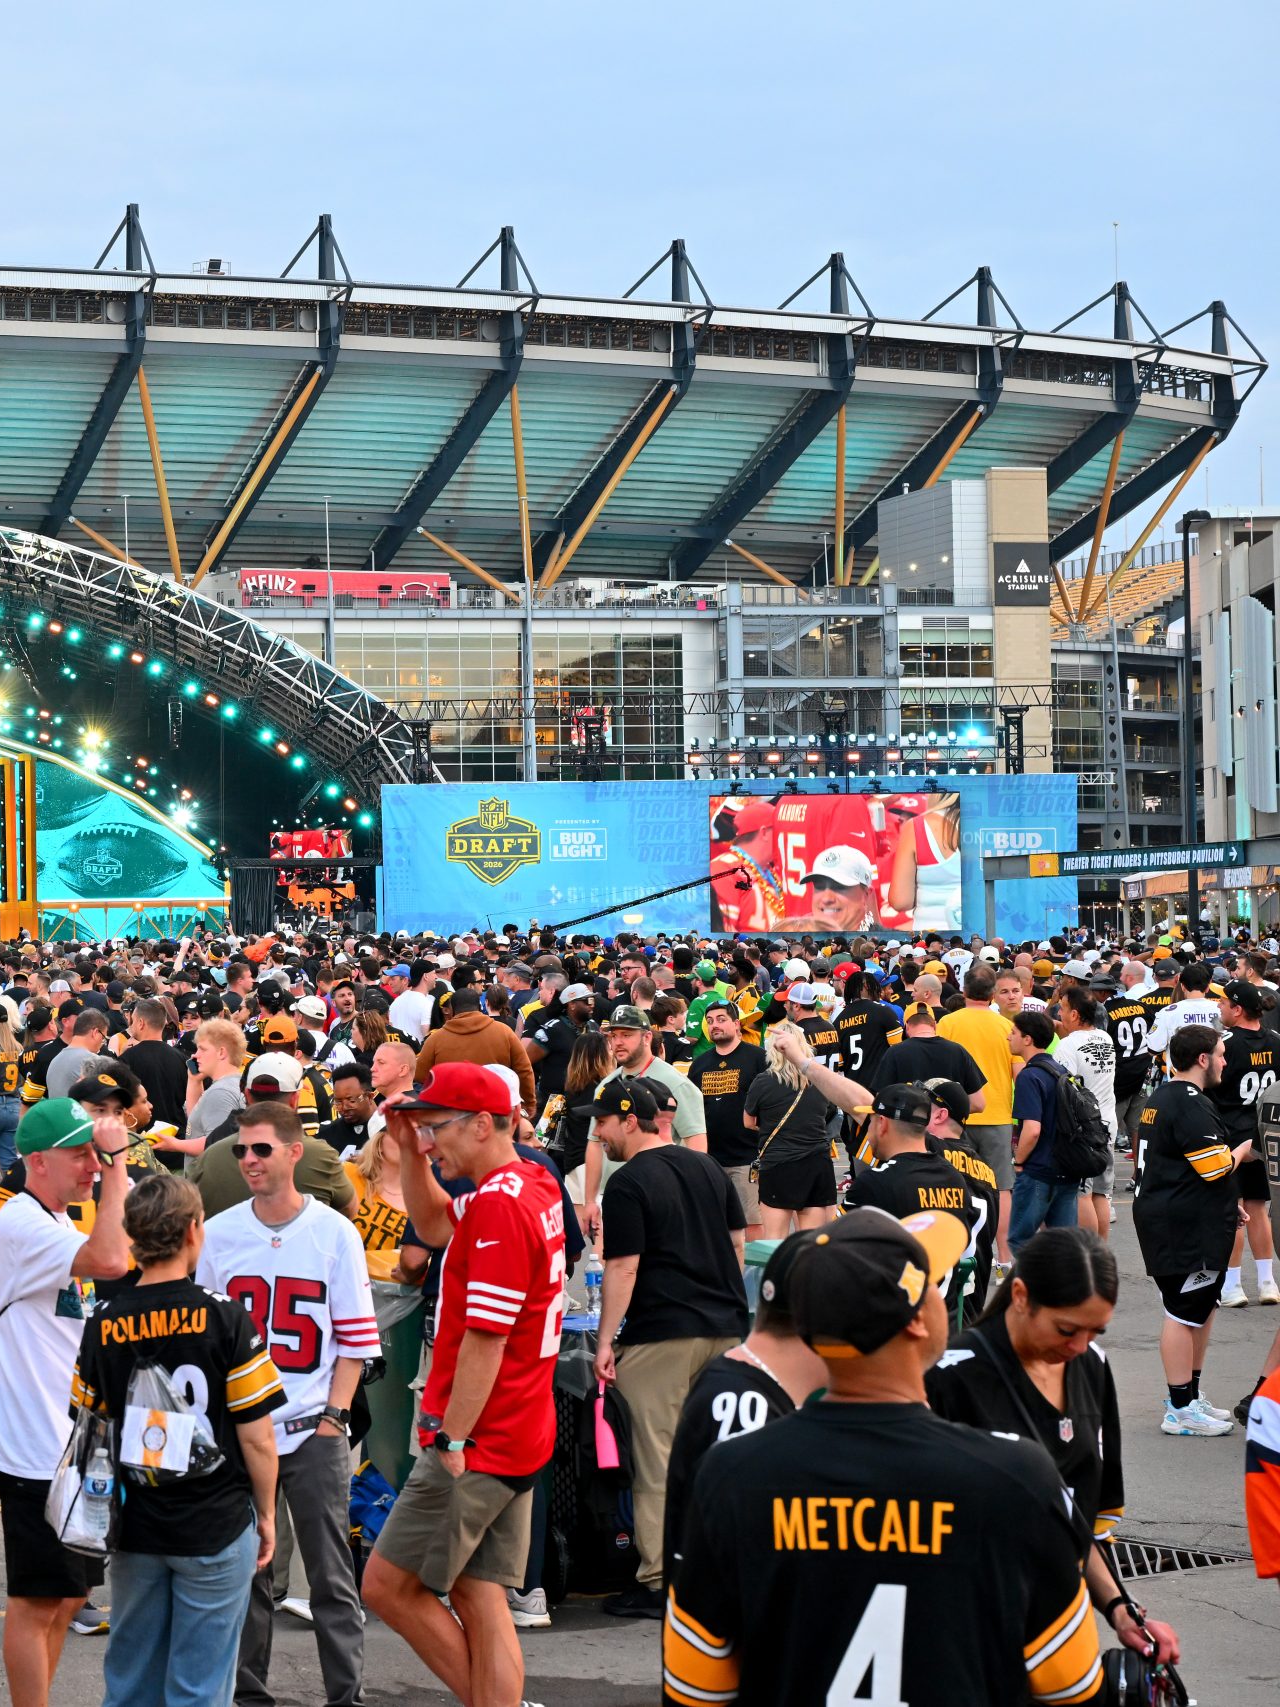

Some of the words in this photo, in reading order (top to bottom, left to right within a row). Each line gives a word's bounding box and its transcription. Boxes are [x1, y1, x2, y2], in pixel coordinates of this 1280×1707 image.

[998, 575, 1049, 583] ACRISURE
[483, 812, 504, 828] NFL
[454, 838, 533, 854] DRAFT
[559, 832, 596, 845] BUD
[994, 833, 1042, 848] BUD
[553, 844, 603, 858] LIGHT
[1063, 857, 1089, 870] THEATER
[1091, 855, 1112, 869] TICKET
[1113, 854, 1142, 868] HOLDERS
[1150, 851, 1191, 866] PITTSBURGH
[1192, 848, 1224, 864] PAVILION
[777, 832, 807, 897] 15
[1142, 997, 1171, 1005] POLAM
[615, 1010, 624, 1020] P
[1109, 1004, 1145, 1021] HARRISON
[1183, 1013, 1206, 1023] SMITH
[839, 1014, 867, 1030] RAMSEY
[808, 1031, 839, 1047] LAMBERT
[1117, 1016, 1148, 1058] 92
[849, 1034, 863, 1071] 5
[1250, 1051, 1273, 1066] WATT
[4, 1064, 19, 1092] 9
[480, 1172, 523, 1198] 23
[918, 1187, 964, 1209] RAMSEY
[359, 1198, 406, 1233] STEE
[101, 1307, 207, 1346] POLAMALU
[712, 1390, 768, 1442] 90
[772, 1497, 955, 1556] METCALF
[826, 1583, 909, 1707] 4
